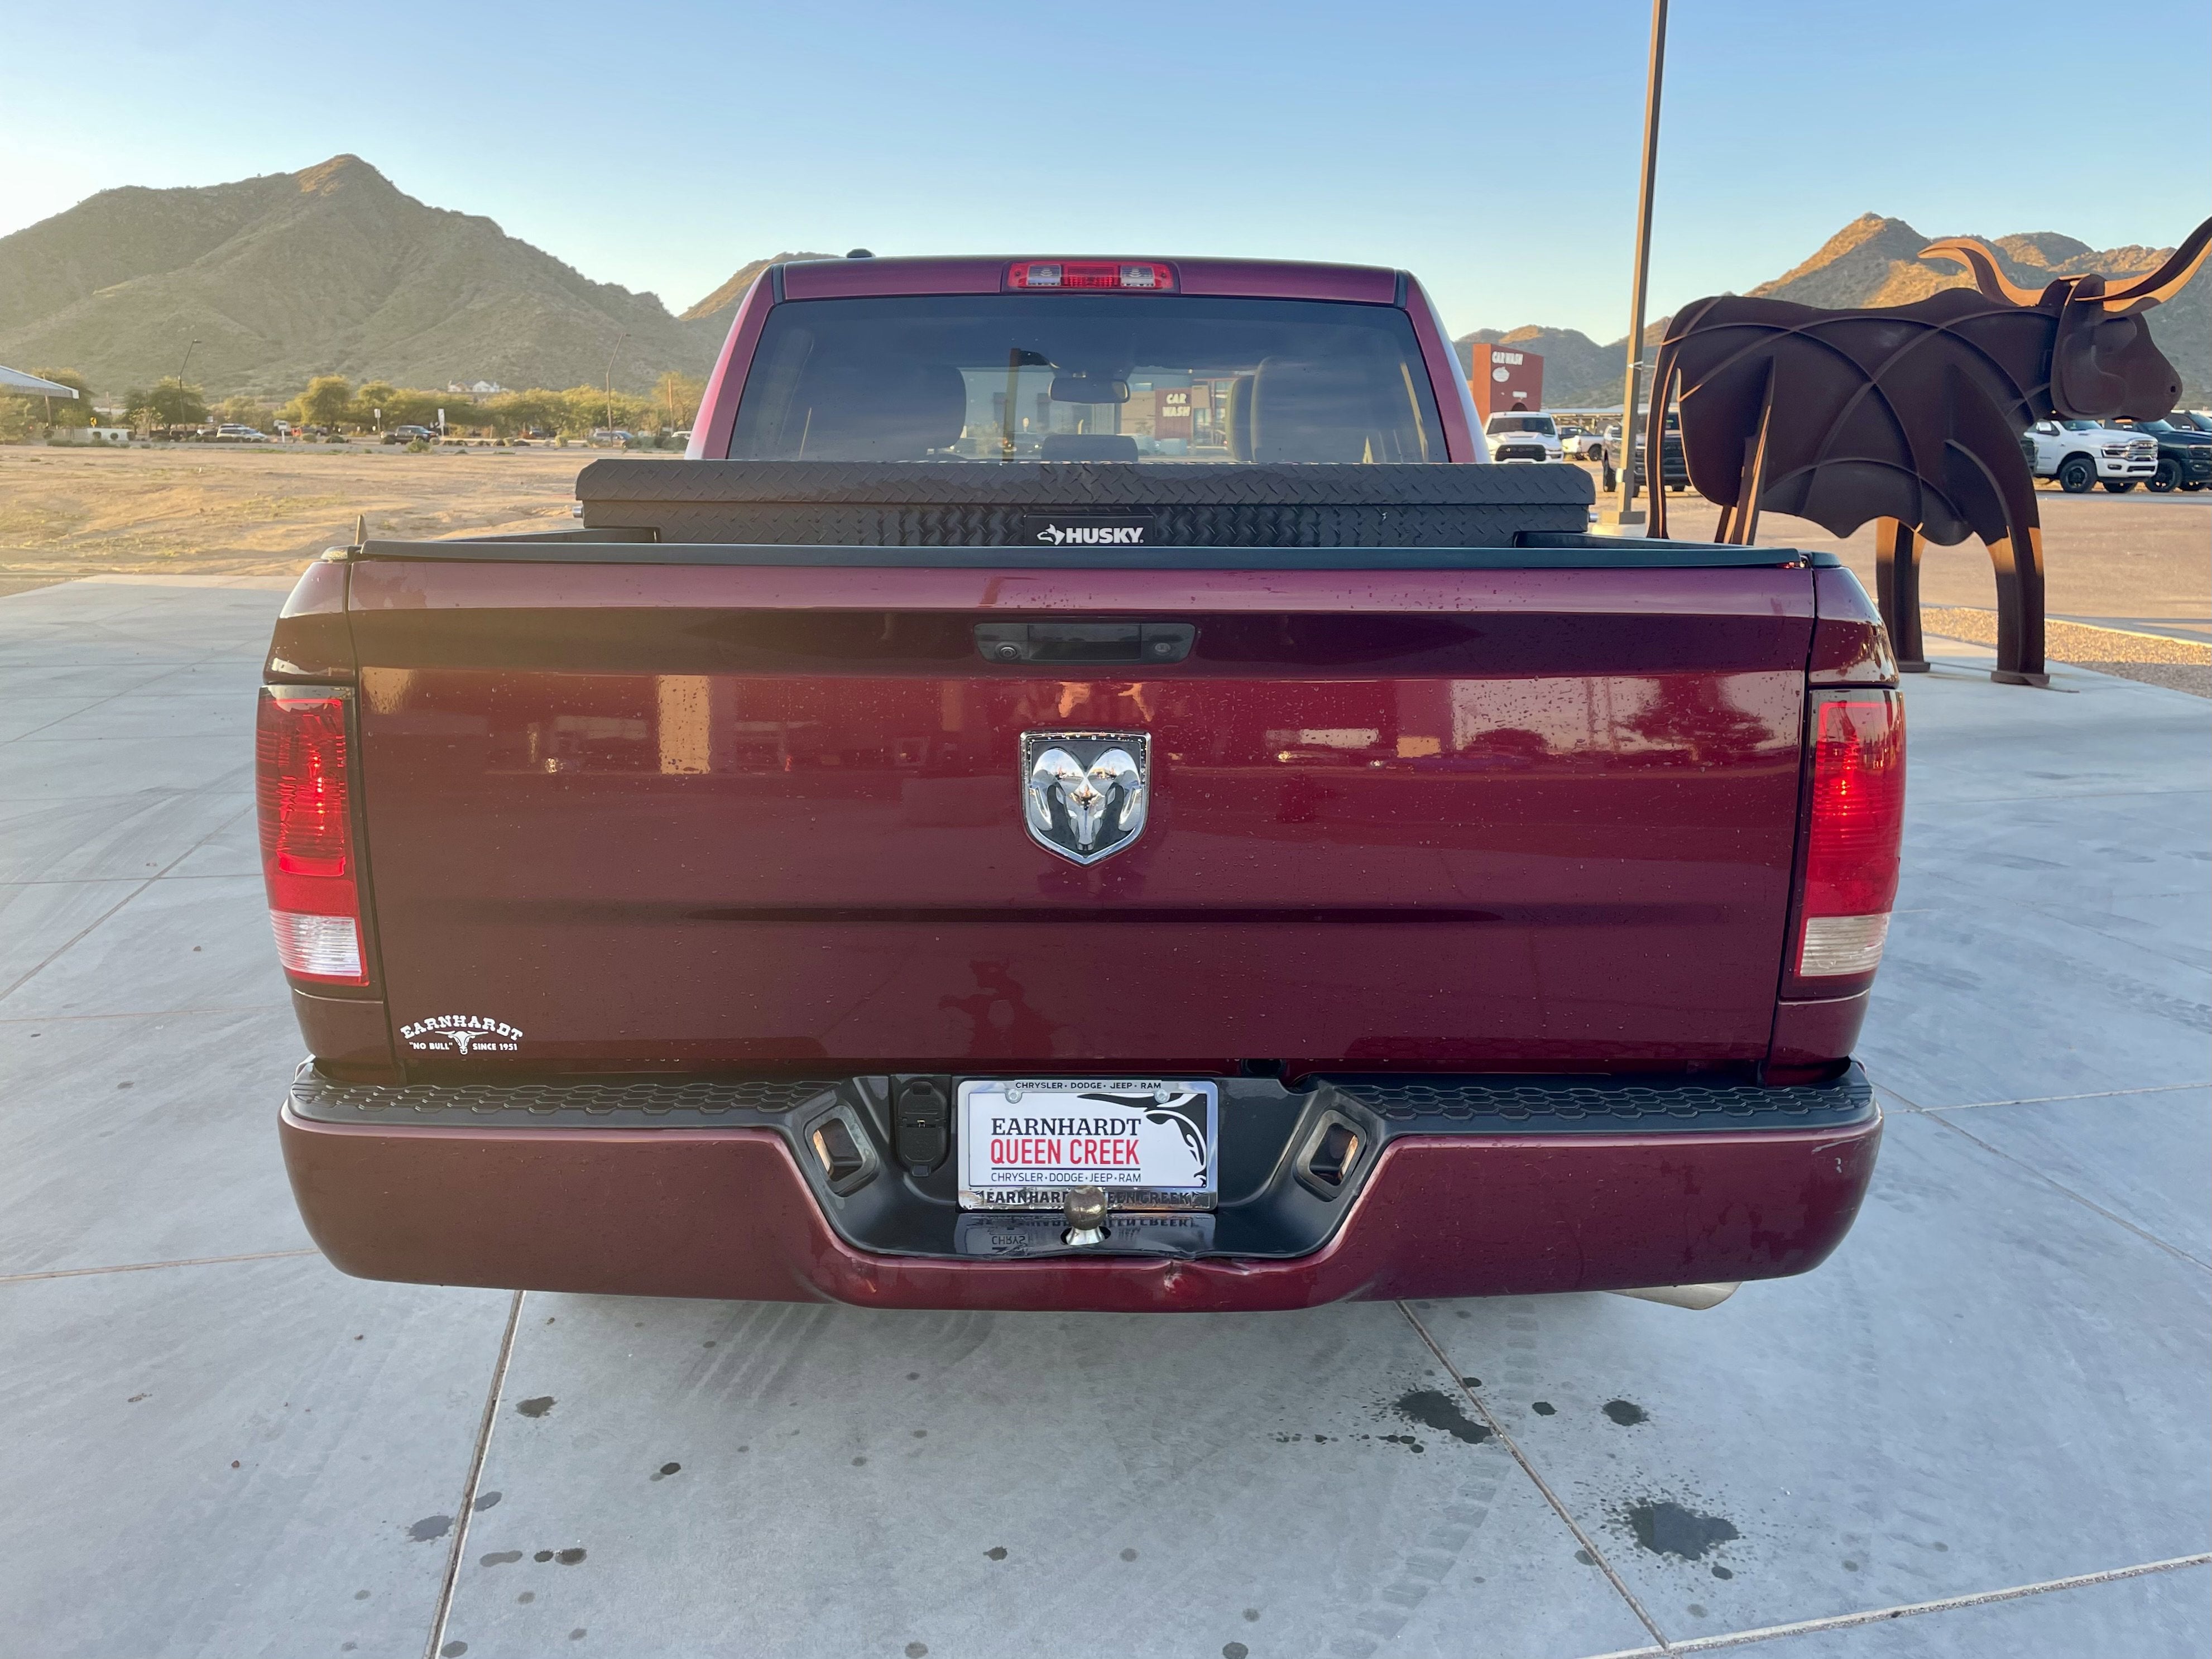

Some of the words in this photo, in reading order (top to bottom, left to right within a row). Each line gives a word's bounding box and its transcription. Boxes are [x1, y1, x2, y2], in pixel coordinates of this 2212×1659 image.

[1166, 393, 1187, 404] CAR
[1162, 406, 1191, 418] WASH
[1066, 527, 1144, 544] HUSKY
[400, 1015, 523, 1041] EARNHARDT
[991, 1118, 1141, 1136] EARNHARDT
[990, 1139, 1061, 1165] QUEEN
[1069, 1139, 1140, 1165] CREEK
[991, 1173, 1044, 1182] CHRYSLER
[1049, 1173, 1083, 1182] DODGE
[1089, 1173, 1113, 1182] JEEP
[1119, 1173, 1141, 1182] RAM
